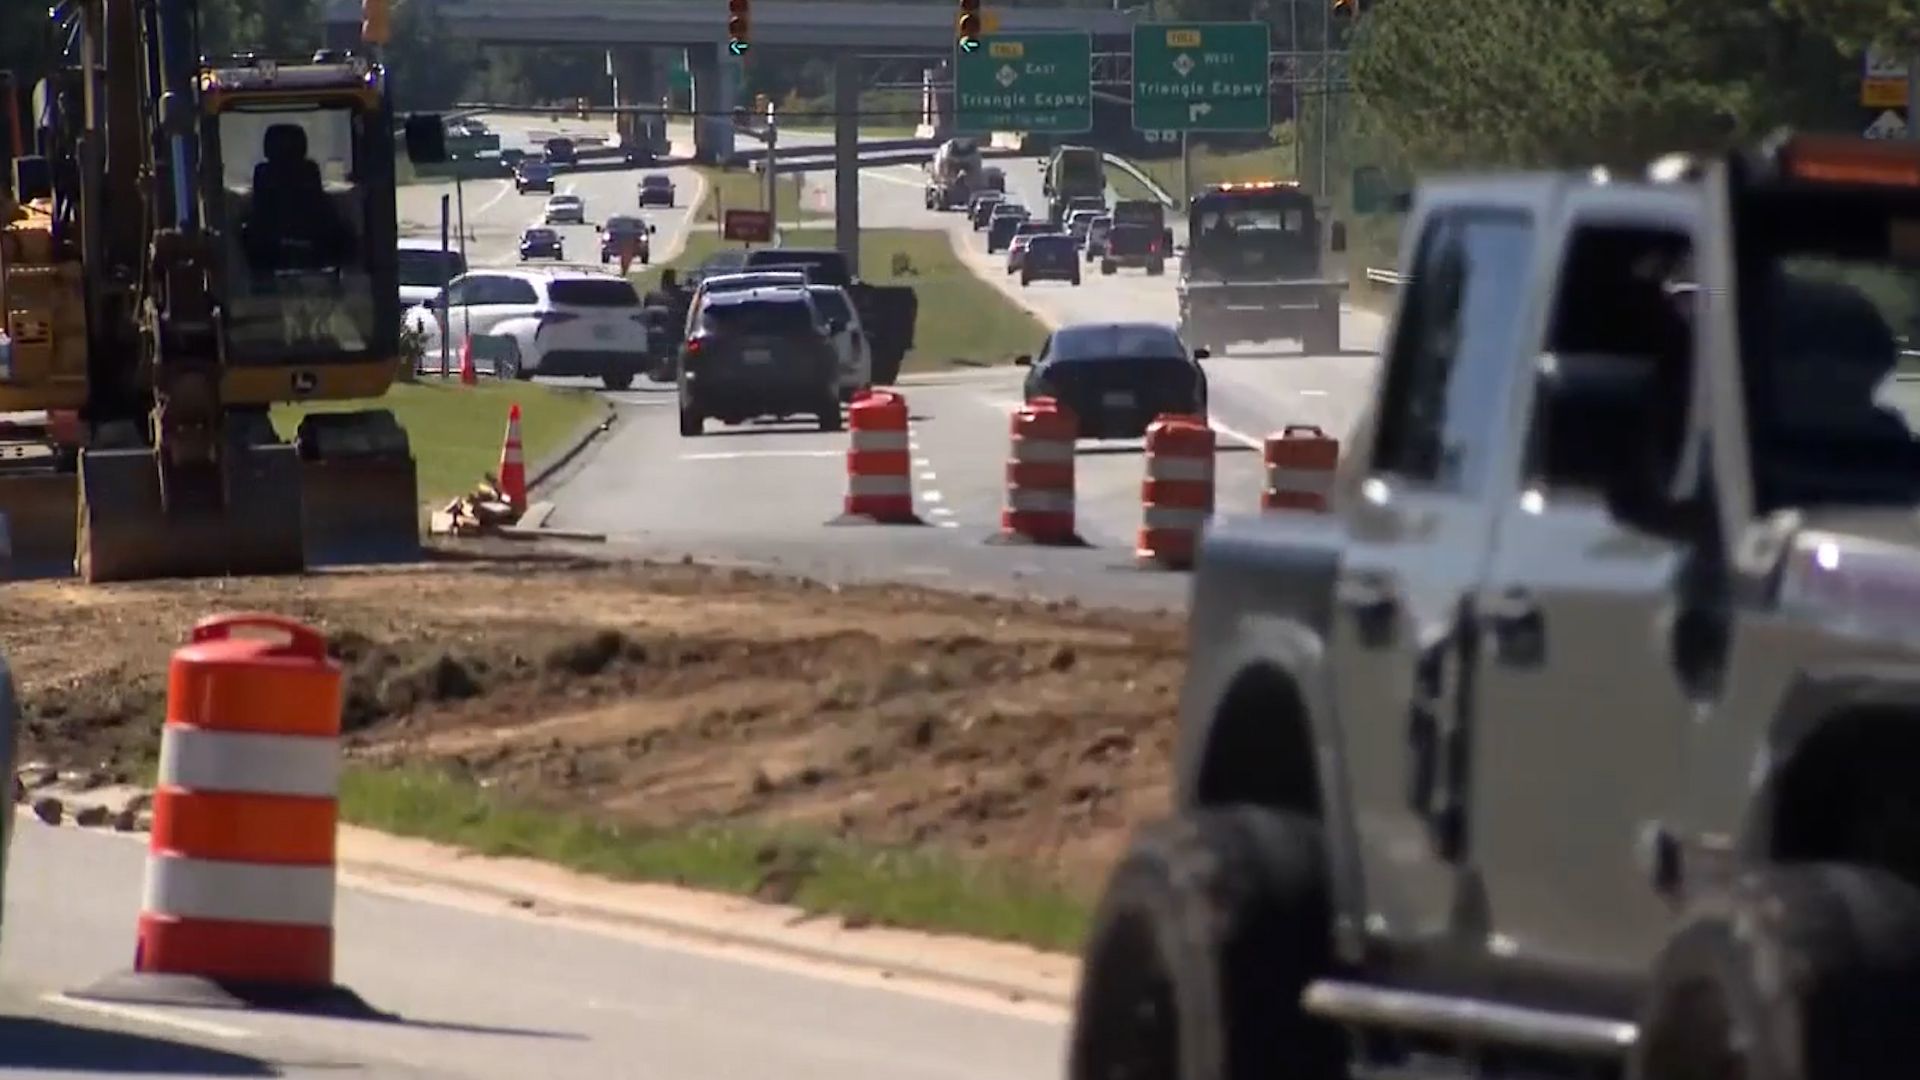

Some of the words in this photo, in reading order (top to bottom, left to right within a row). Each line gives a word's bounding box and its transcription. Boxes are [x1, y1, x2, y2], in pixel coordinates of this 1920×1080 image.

[1139, 82, 1204, 98] Triangle
[1212, 82, 1263, 97] Expwy
[961, 92, 1025, 108] Triangle
[1035, 92, 1086, 107] Expwy
